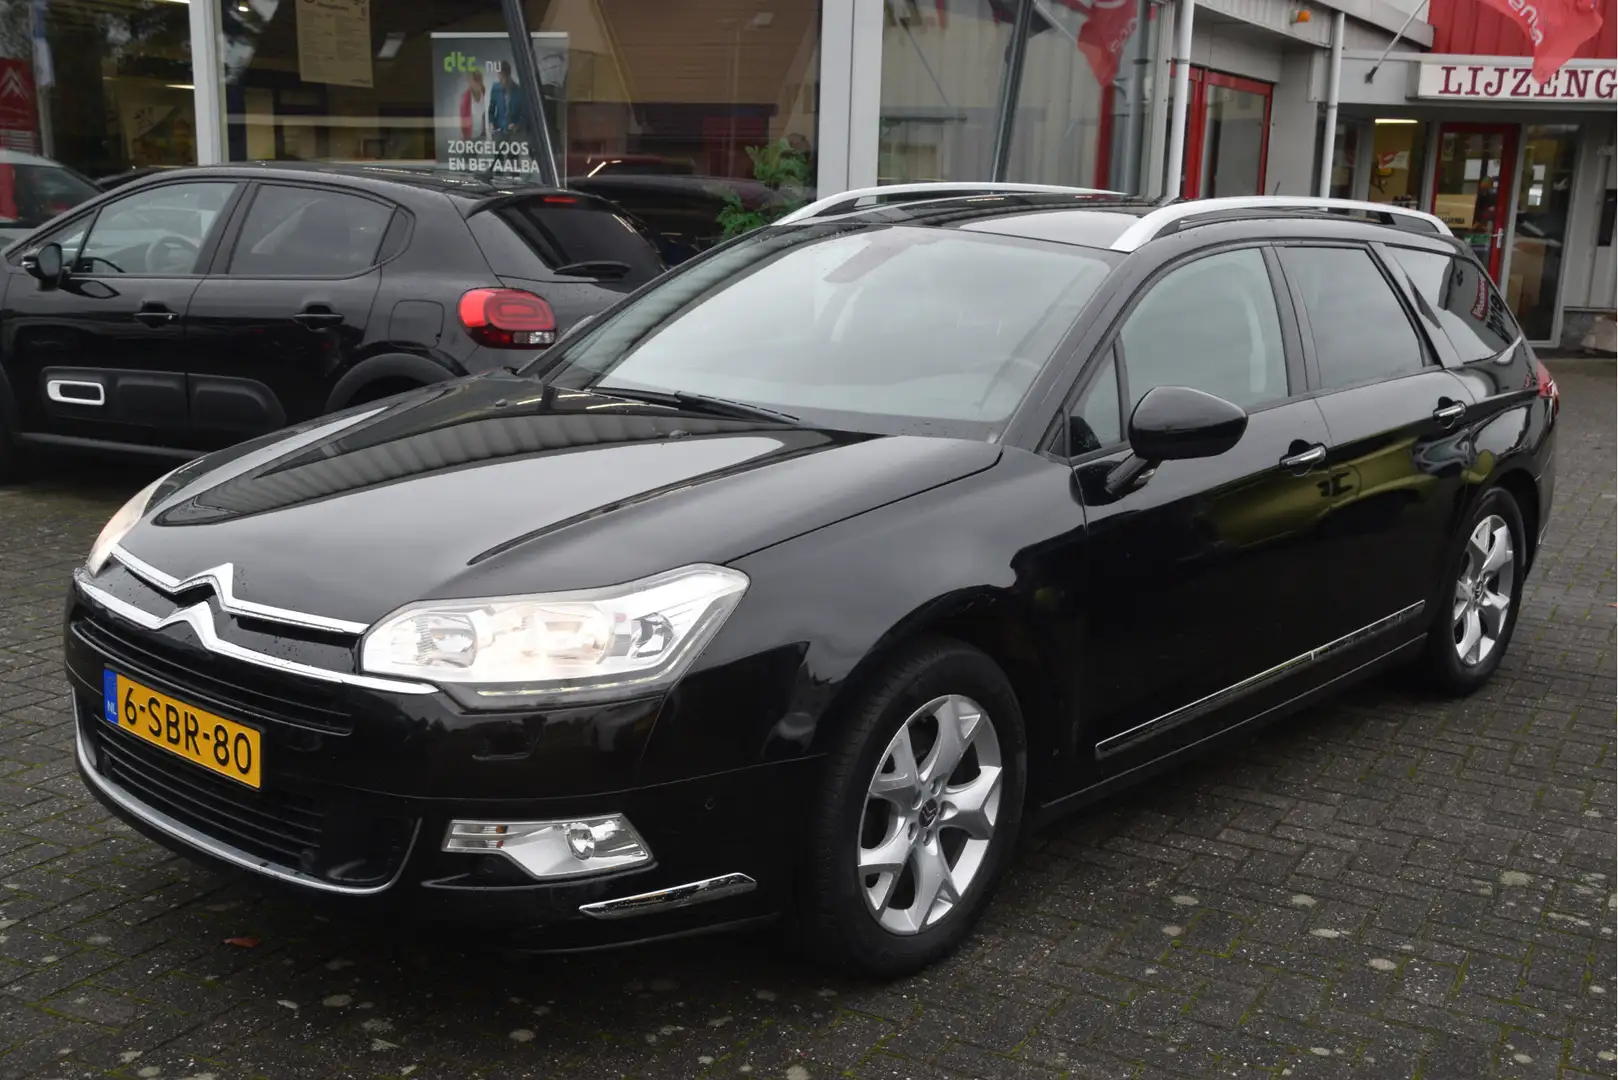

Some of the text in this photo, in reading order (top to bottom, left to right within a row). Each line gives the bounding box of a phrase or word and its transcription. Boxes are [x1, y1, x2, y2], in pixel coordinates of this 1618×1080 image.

[486, 61, 502, 73] nu
[448, 141, 529, 155] ZORGELOOS
[449, 158, 466, 171] EN
[107, 700, 118, 715] NL
[124, 688, 252, 775] 6-SBR-80
